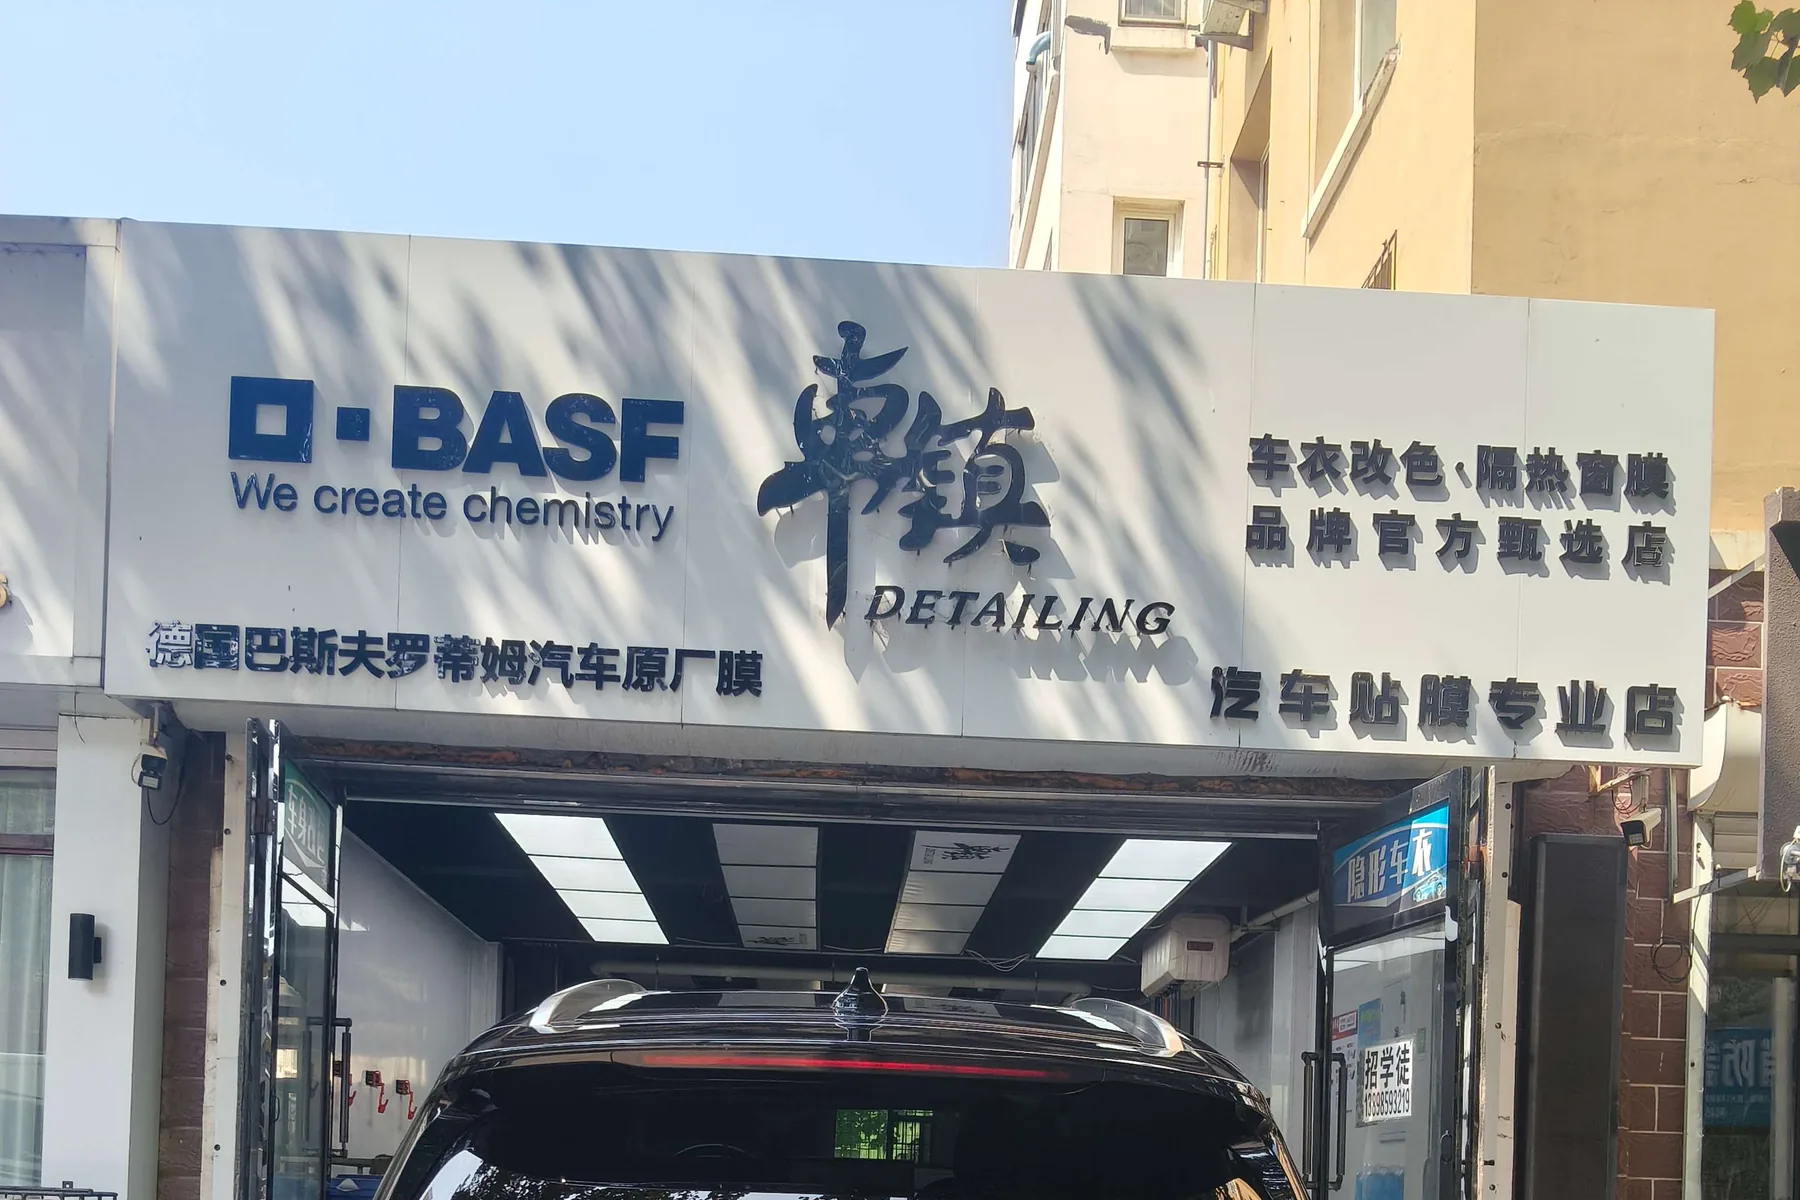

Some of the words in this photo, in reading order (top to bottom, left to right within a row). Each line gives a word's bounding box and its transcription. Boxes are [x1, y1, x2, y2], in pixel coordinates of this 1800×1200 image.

[391, 385, 684, 482] BASF
[230, 471, 297, 511] We
[313, 481, 448, 520] create
[463, 486, 675, 541] chemistry
[1246, 505, 1668, 568] 品牌官方甄选店
[864, 585, 1175, 635] DETAILING
[147, 620, 764, 698] 德国巴斯夫罗蒂姆汽车原厂膜
[1209, 665, 1679, 737] 汽车贴膜专业店
[1347, 828, 1433, 903] 隐形车衣
[1365, 1043, 1410, 1090] 招学徒
